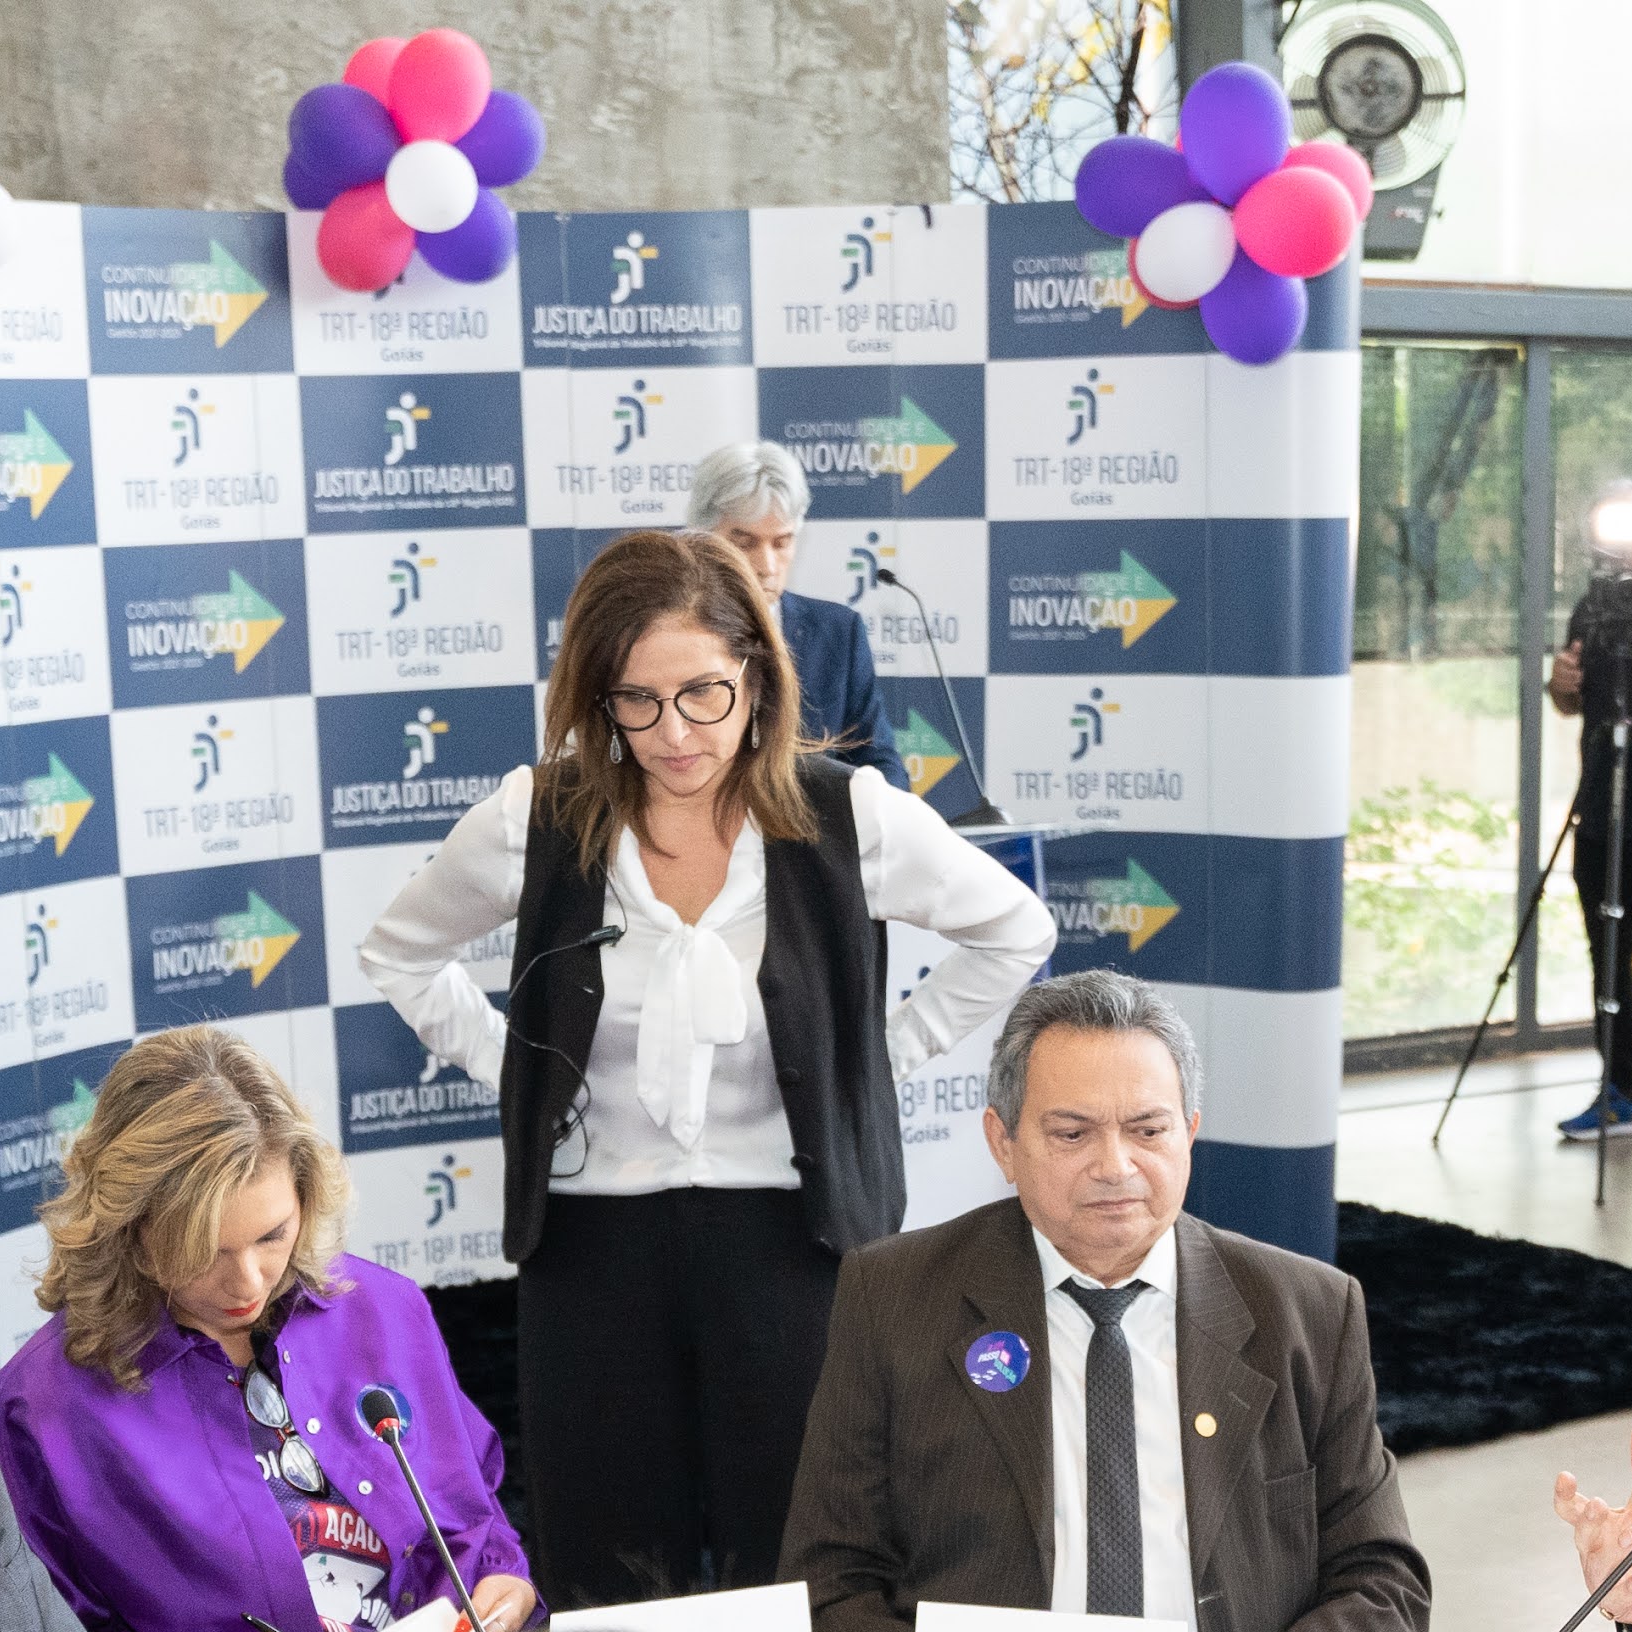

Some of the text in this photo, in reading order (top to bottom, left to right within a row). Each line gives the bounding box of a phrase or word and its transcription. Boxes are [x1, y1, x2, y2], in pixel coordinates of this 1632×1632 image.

[104, 284, 230, 331] INOVAÇÃO
[1014, 269, 1137, 314] INOVAÇÃO
[2, 304, 64, 342] REGIÃO
[319, 305, 489, 343] TRT-18ª REGIÃO
[532, 303, 743, 338] JUSTIÇA DO TRABALHO
[783, 299, 957, 335] TRT-18ª REGIÃO
[380, 346, 425, 363] Goiás
[846, 338, 893, 353] Goiás
[314, 464, 514, 501] JUSTIÇA DO TRABALHO
[555, 463, 695, 495] TRT-18ª REG
[1013, 450, 1179, 487] TRT-18ª REGIÃO
[123, 477, 200, 511] TRT-18ª
[203, 471, 279, 507] REGIÃO
[619, 499, 664, 515] Goiás
[1070, 490, 1115, 507] Goiás
[1009, 589, 1138, 634] INOVAÇÃO
[127, 612, 248, 661] INOVAÇÃO
[335, 628, 418, 662] TRT-18ª
[424, 620, 505, 657] REGIÃO
[397, 661, 441, 678] Goiás
[331, 774, 502, 816] JUSTIÇA DO TRABAL
[1013, 766, 1184, 801] TRT-18ª REGIÃO
[143, 805, 220, 839] TRT-18ª
[224, 792, 295, 833] REGIÃO
[1075, 804, 1121, 821] Goiás
[201, 836, 240, 854] Goiás
[1047, 896, 1144, 938] OVAÇÃO
[153, 929, 266, 981] INOVAÇÃO
[350, 1088, 417, 1122] JUSTIÇA
[418, 1084, 442, 1114] DO
[934, 1074, 988, 1113] REGI
[903, 1123, 950, 1145] Goiás
[372, 1230, 504, 1270] TRT-18ª REG
